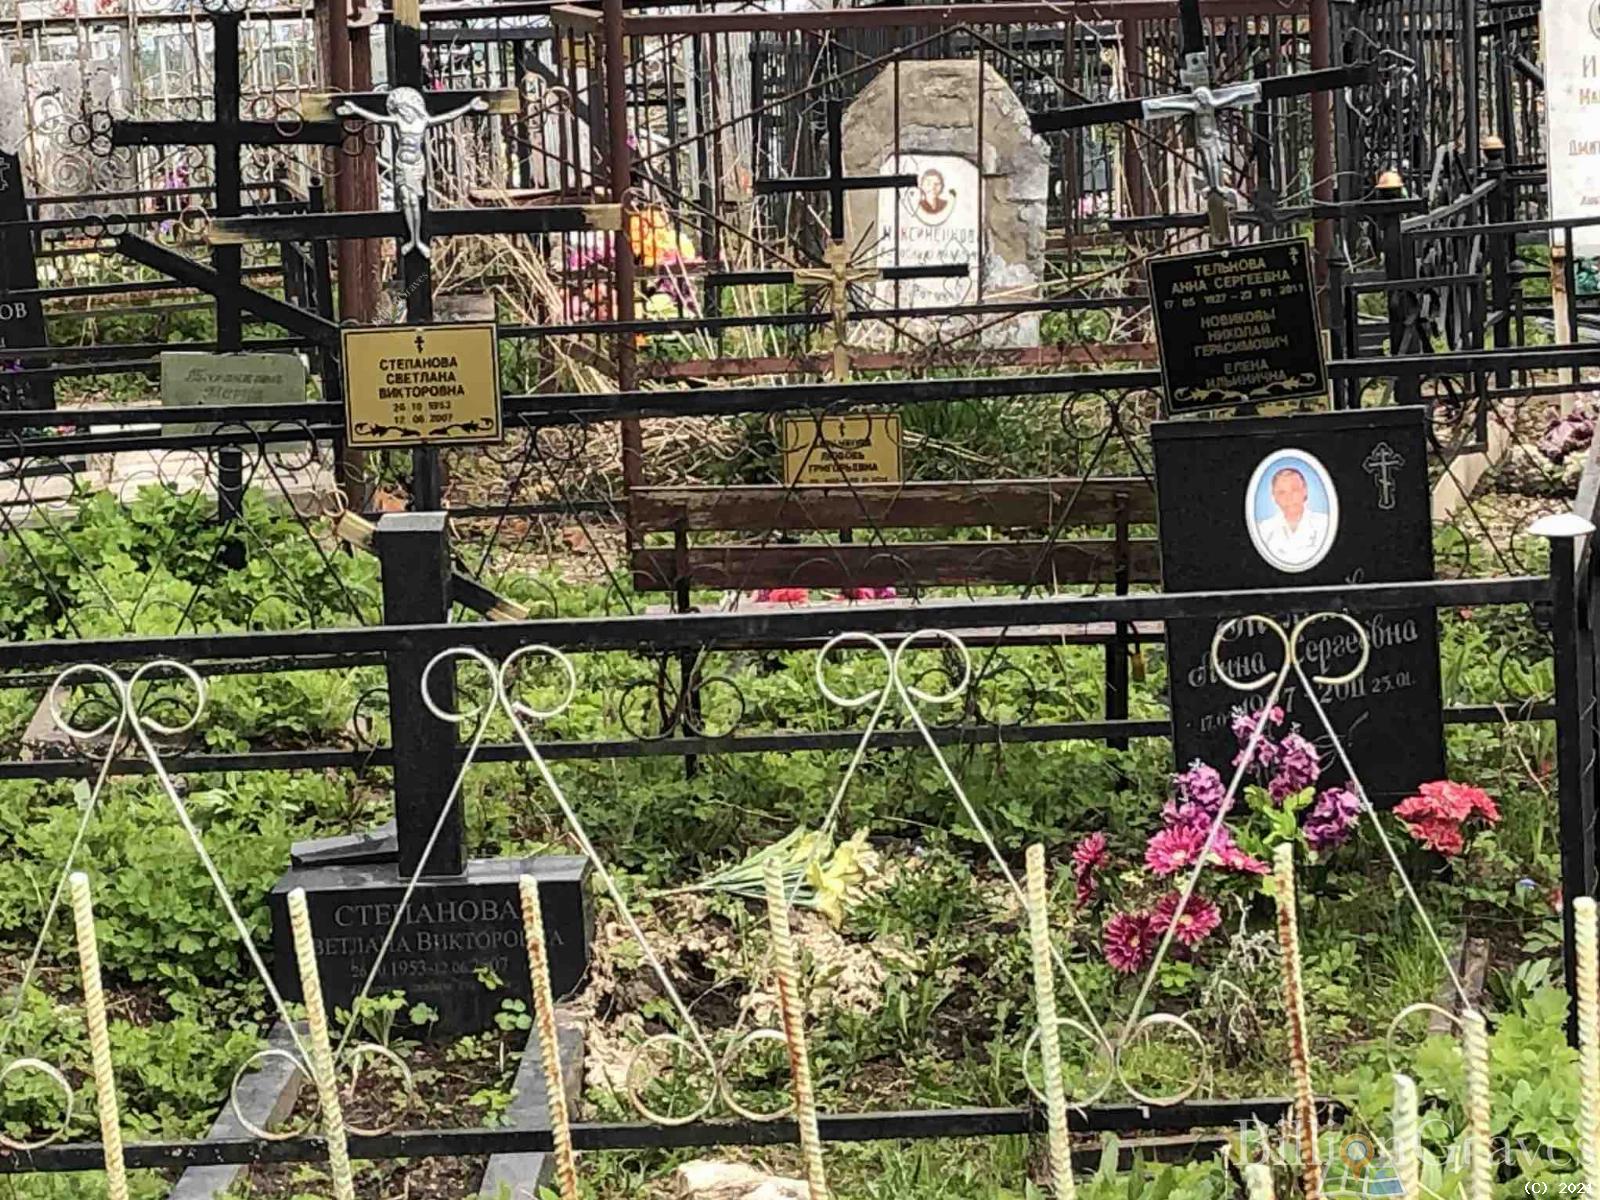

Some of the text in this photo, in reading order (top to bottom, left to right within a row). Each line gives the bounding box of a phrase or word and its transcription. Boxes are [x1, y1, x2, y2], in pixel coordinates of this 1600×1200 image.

[1194, 257, 1267, 277] ТЕЛЬНОВА
[1171, 270, 1291, 295] АННА СЕРГЕЕВНА
[1200, 308, 1276, 329] НОВИКОВЫ
[1208, 326, 1271, 343] НИКОЛАЙ
[1193, 335, 1289, 358] ГЕРАСИМОВИЧ
[379, 356, 458, 371] СТЕПАНОВА
[1223, 358, 1269, 375] ЕЛЕНА
[386, 371, 456, 385] СВЕТЛАНА
[378, 385, 465, 399] ВИКТОРОВНА
[312, 929, 565, 956] ВЕТЛАА ВИКТОРОА
